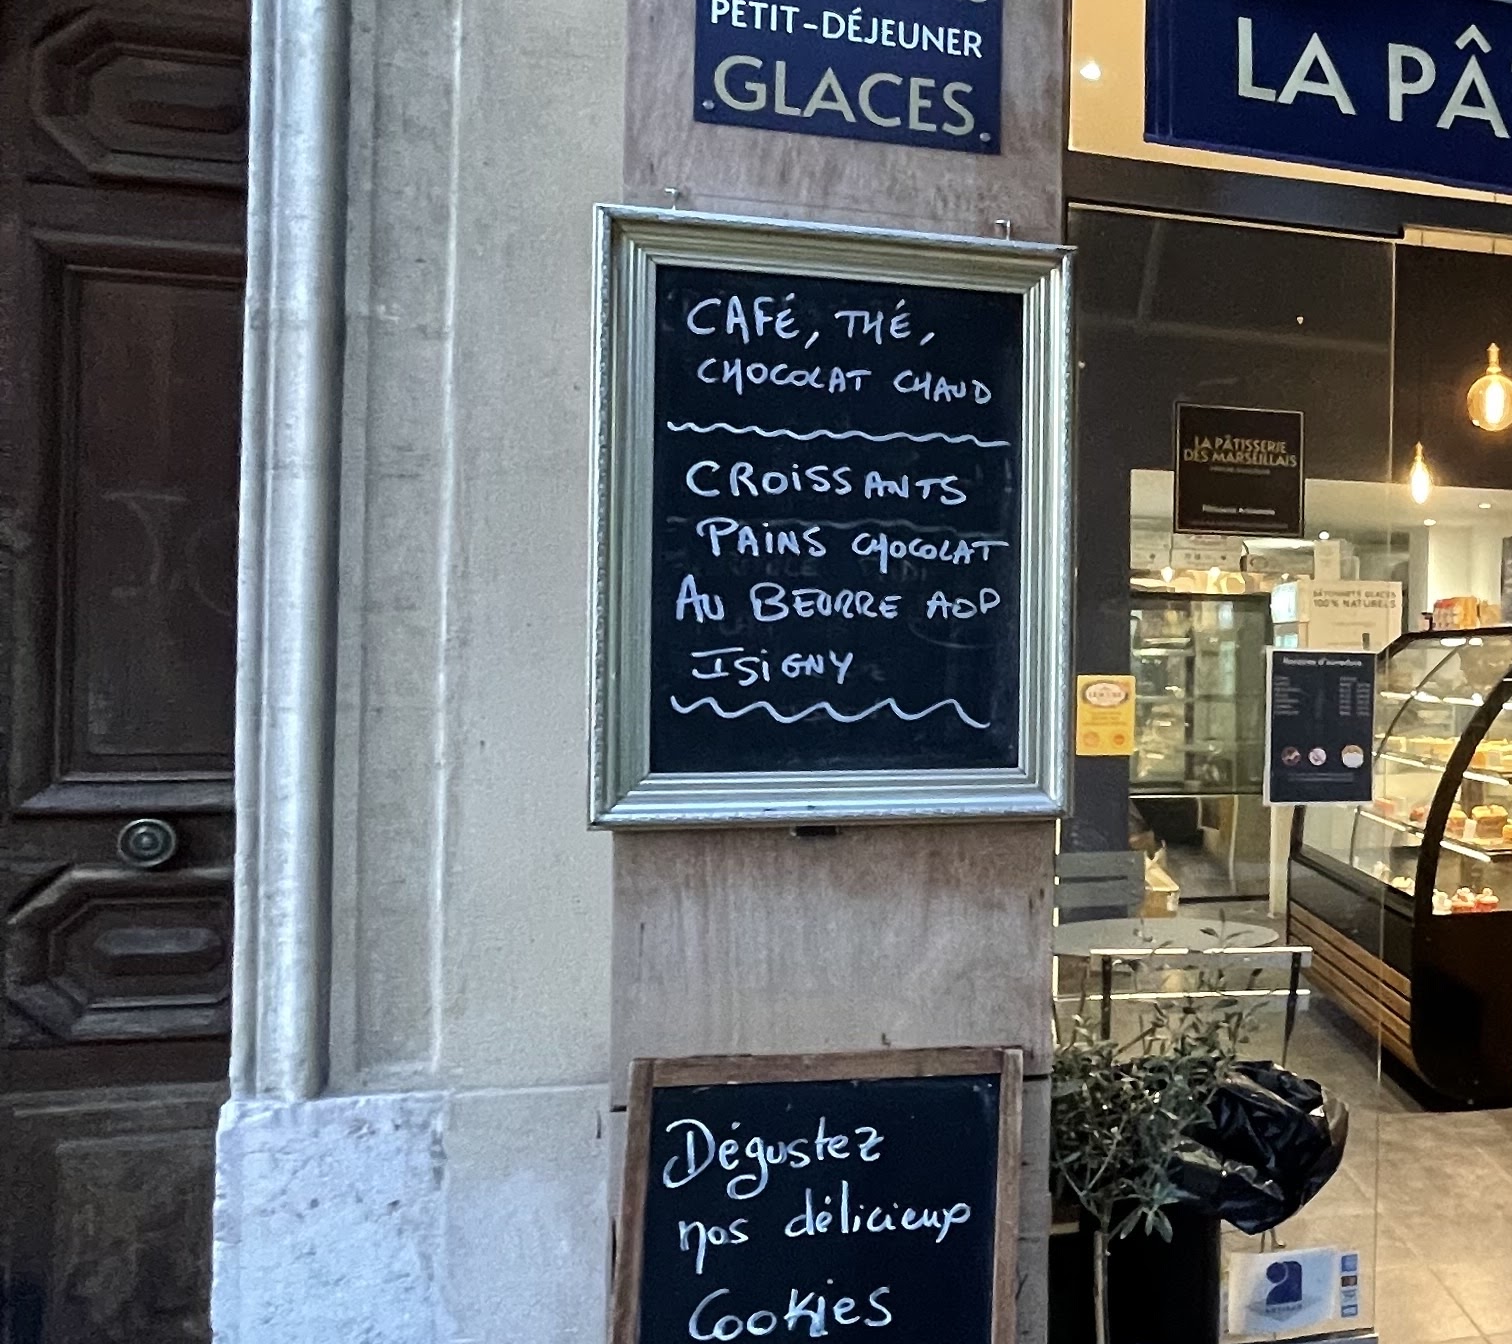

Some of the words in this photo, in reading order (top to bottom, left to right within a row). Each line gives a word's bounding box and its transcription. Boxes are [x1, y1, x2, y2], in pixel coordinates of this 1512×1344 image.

[1236, 16, 1358, 117] LA
[713, 54, 976, 137] GLACES
[686, 293, 822, 349] CAFÉ,
[834, 299, 937, 347] THÉ,
[696, 357, 873, 396] CHOCOLAT
[892, 369, 994, 406] CHAUD
[1183, 448, 1209, 464] DES
[1211, 450, 1298, 469] MARSEILLAIS
[1194, 435, 1213, 450] LA
[1214, 433, 1287, 455] PÂTISSERIE
[750, 581, 902, 623] BEURRE
[661, 1115, 885, 1200] Dégustez
[678, 1217, 750, 1275] nos
[687, 1277, 894, 1342] Cookies
